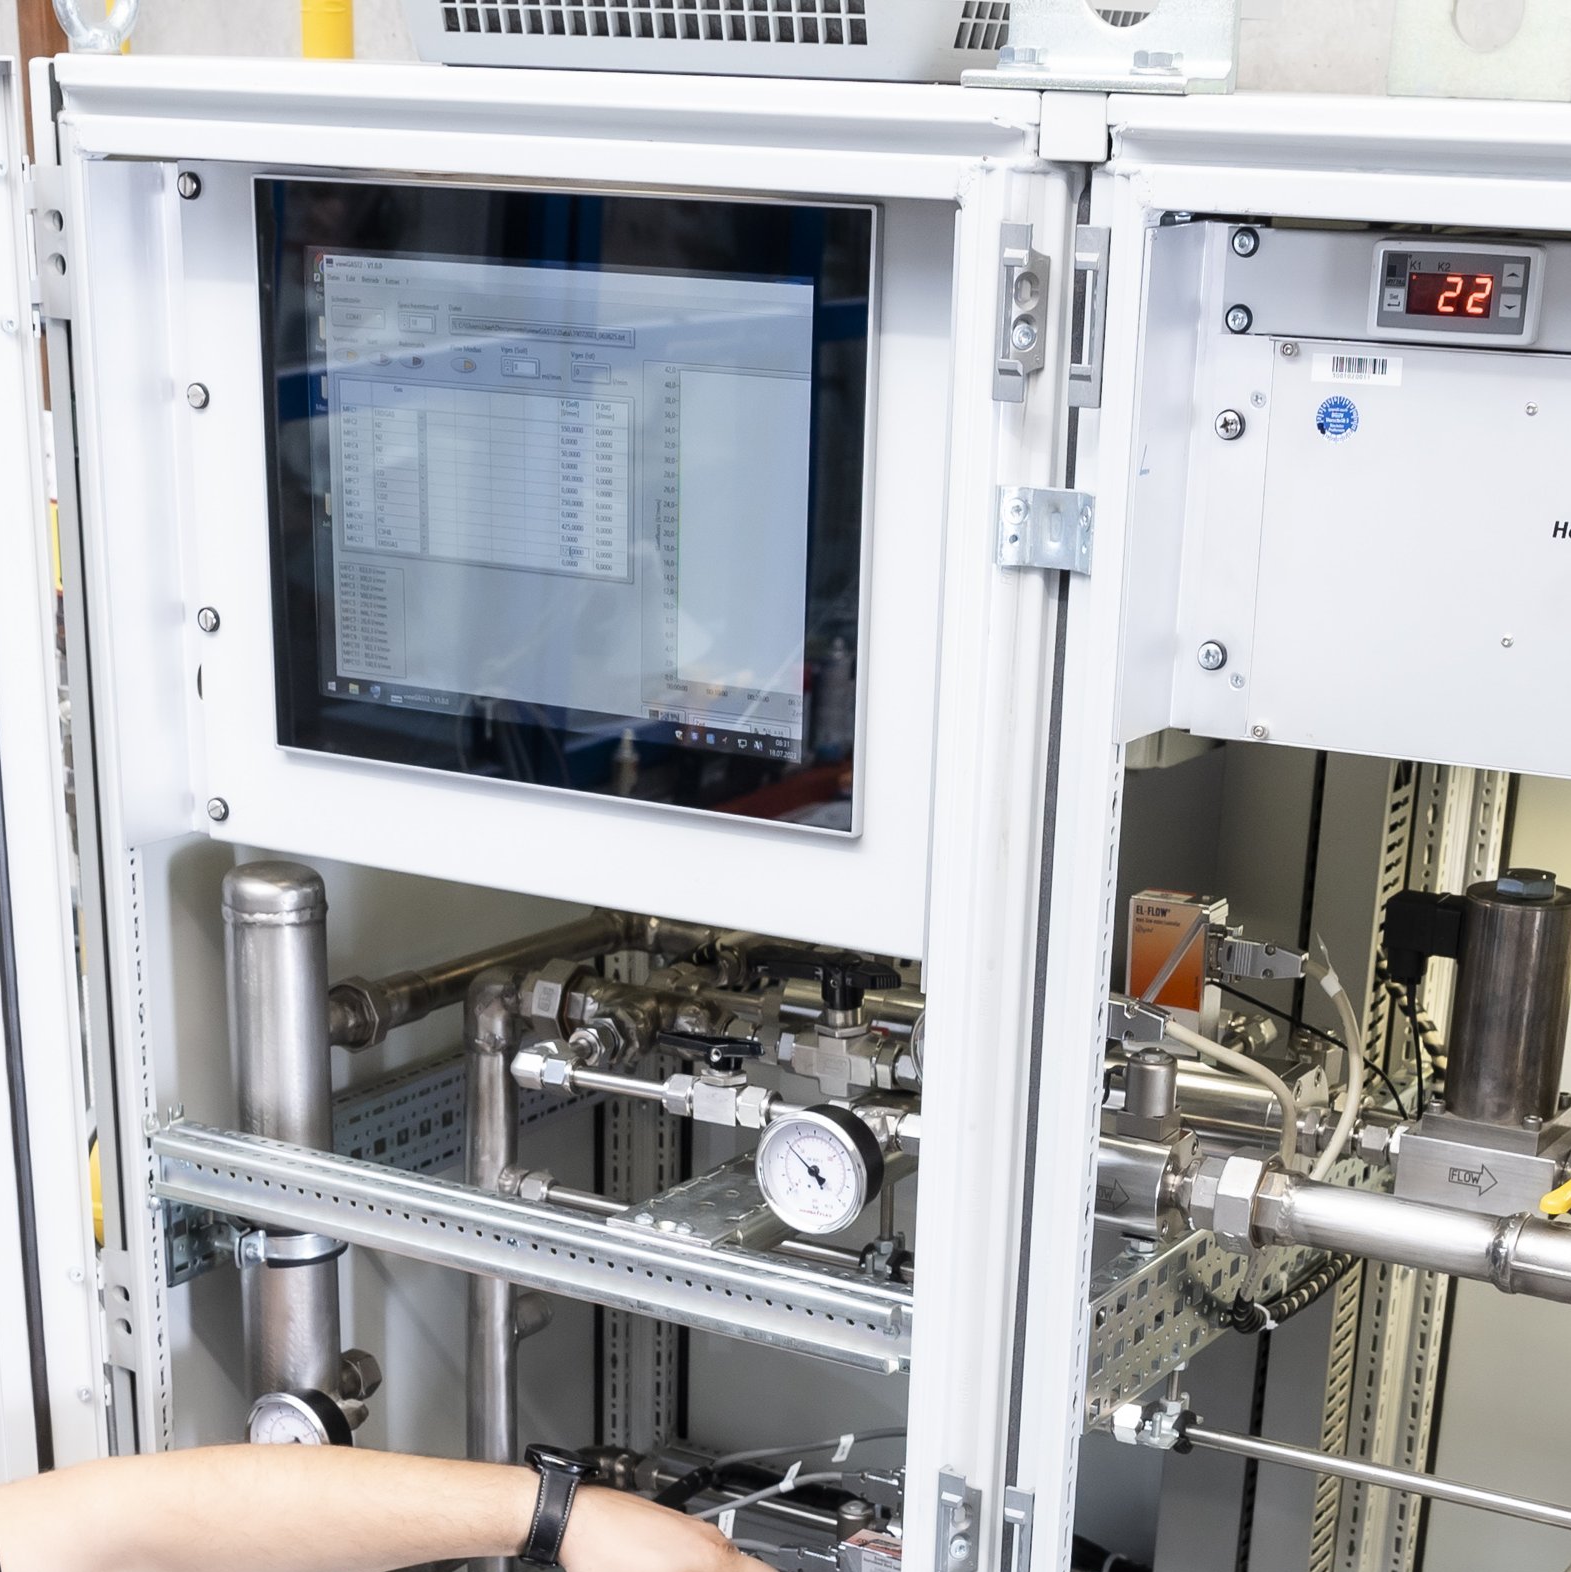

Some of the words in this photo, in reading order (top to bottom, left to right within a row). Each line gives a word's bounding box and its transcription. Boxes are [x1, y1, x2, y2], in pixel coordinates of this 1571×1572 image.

[1409, 261, 1422, 271] K1
[1437, 262, 1451, 272] K2
[1437, 276, 1492, 314] 22
[1449, 1166, 1480, 1186] FLOW
